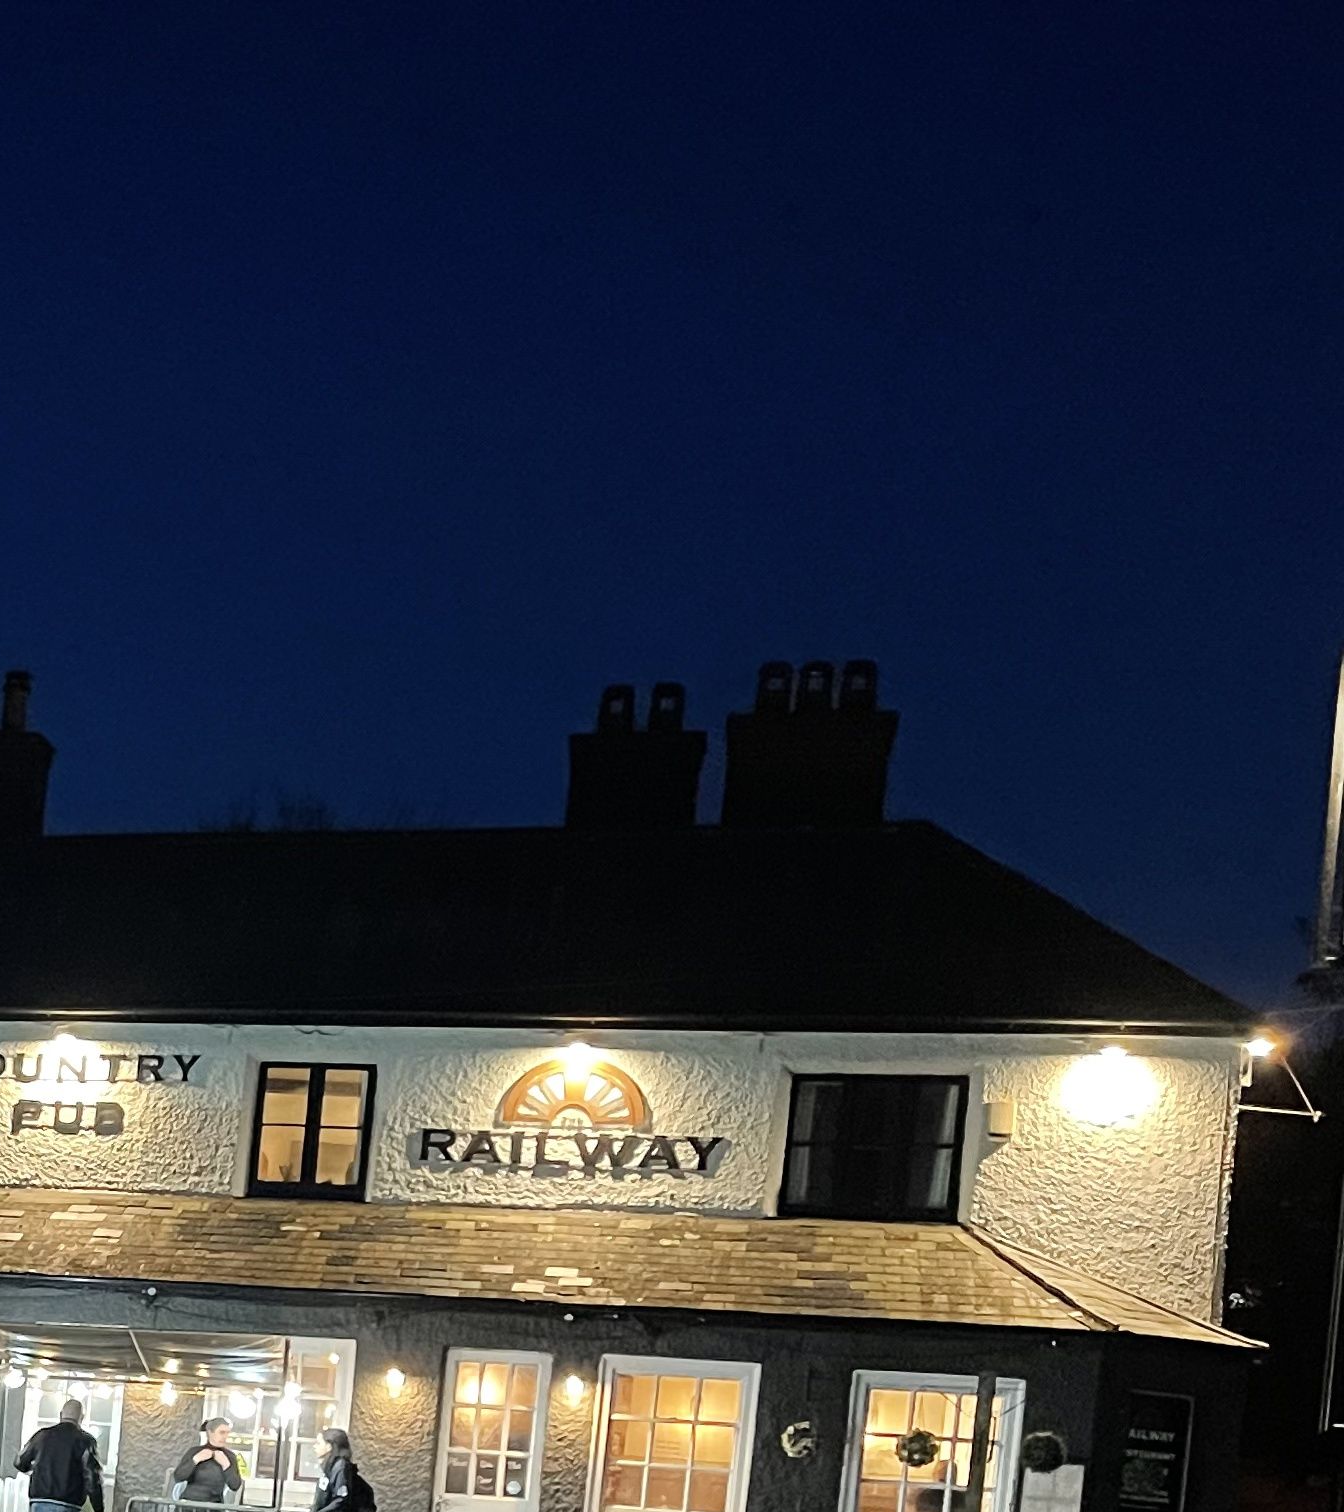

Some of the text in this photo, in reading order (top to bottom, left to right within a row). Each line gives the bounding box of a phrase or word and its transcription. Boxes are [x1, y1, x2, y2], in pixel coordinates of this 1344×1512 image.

[10, 1100, 124, 1135] PUB
[418, 1128, 724, 1171] RAILWAY
[1126, 1427, 1176, 1443] AILWAY
